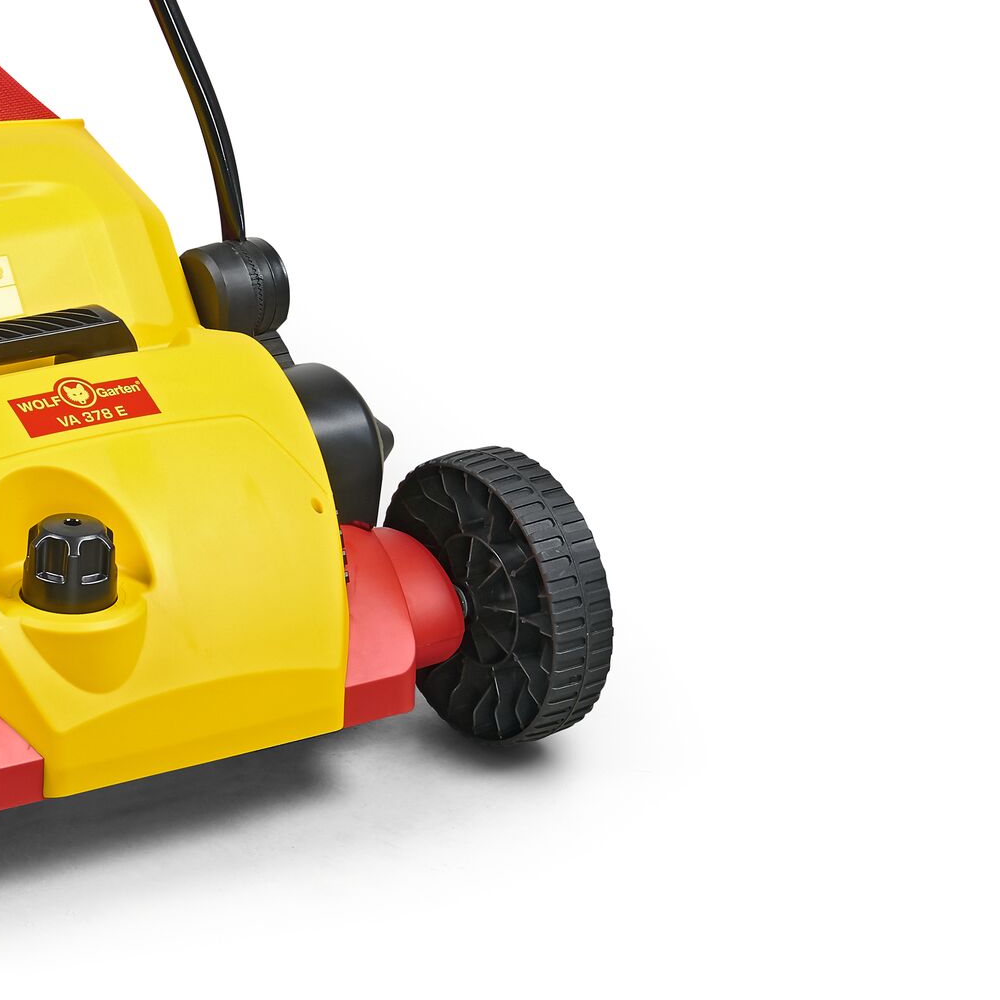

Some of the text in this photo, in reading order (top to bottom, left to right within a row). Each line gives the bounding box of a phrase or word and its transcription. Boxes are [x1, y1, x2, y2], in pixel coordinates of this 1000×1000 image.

[16, 395, 62, 413] WOLF
[56, 405, 128, 428] VA 378 E
